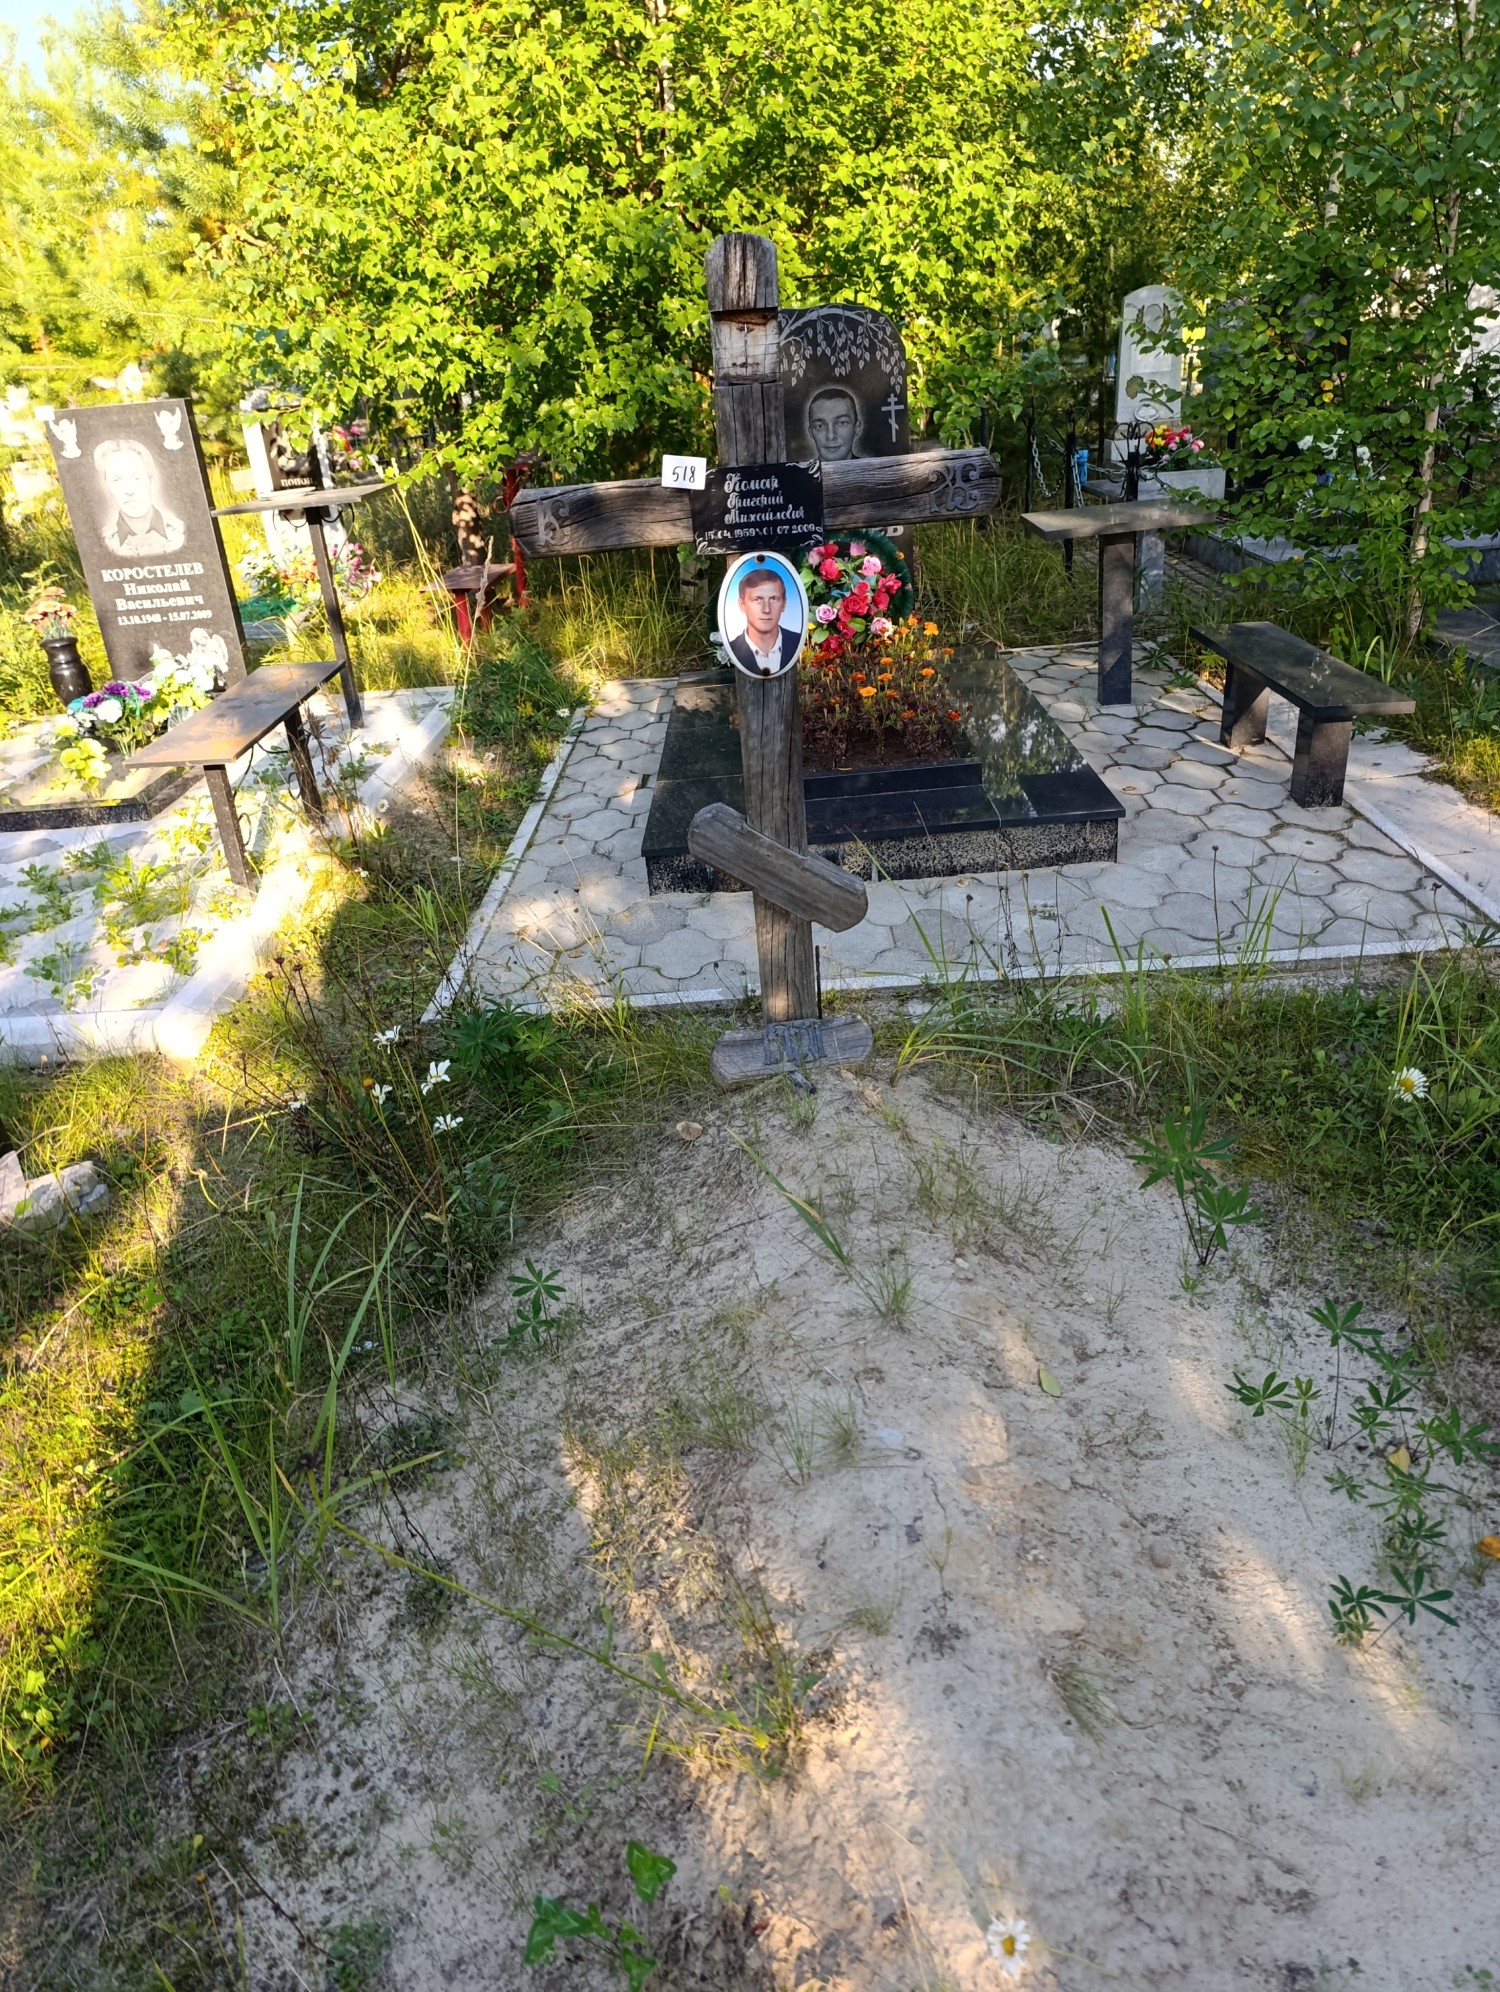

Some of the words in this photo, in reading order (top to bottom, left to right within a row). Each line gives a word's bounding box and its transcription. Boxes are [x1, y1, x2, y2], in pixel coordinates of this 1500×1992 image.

[672, 465, 696, 483] 518
[724, 472, 779, 493] Комар
[727, 490, 784, 509] Григорий
[724, 503, 805, 525] Михайлович
[101, 562, 204, 582] КОРОСТЕЛЕВ
[122, 579, 191, 596] Николай
[114, 595, 204, 611] Васильевич
[168, 609, 213, 622] 15.07.2009
